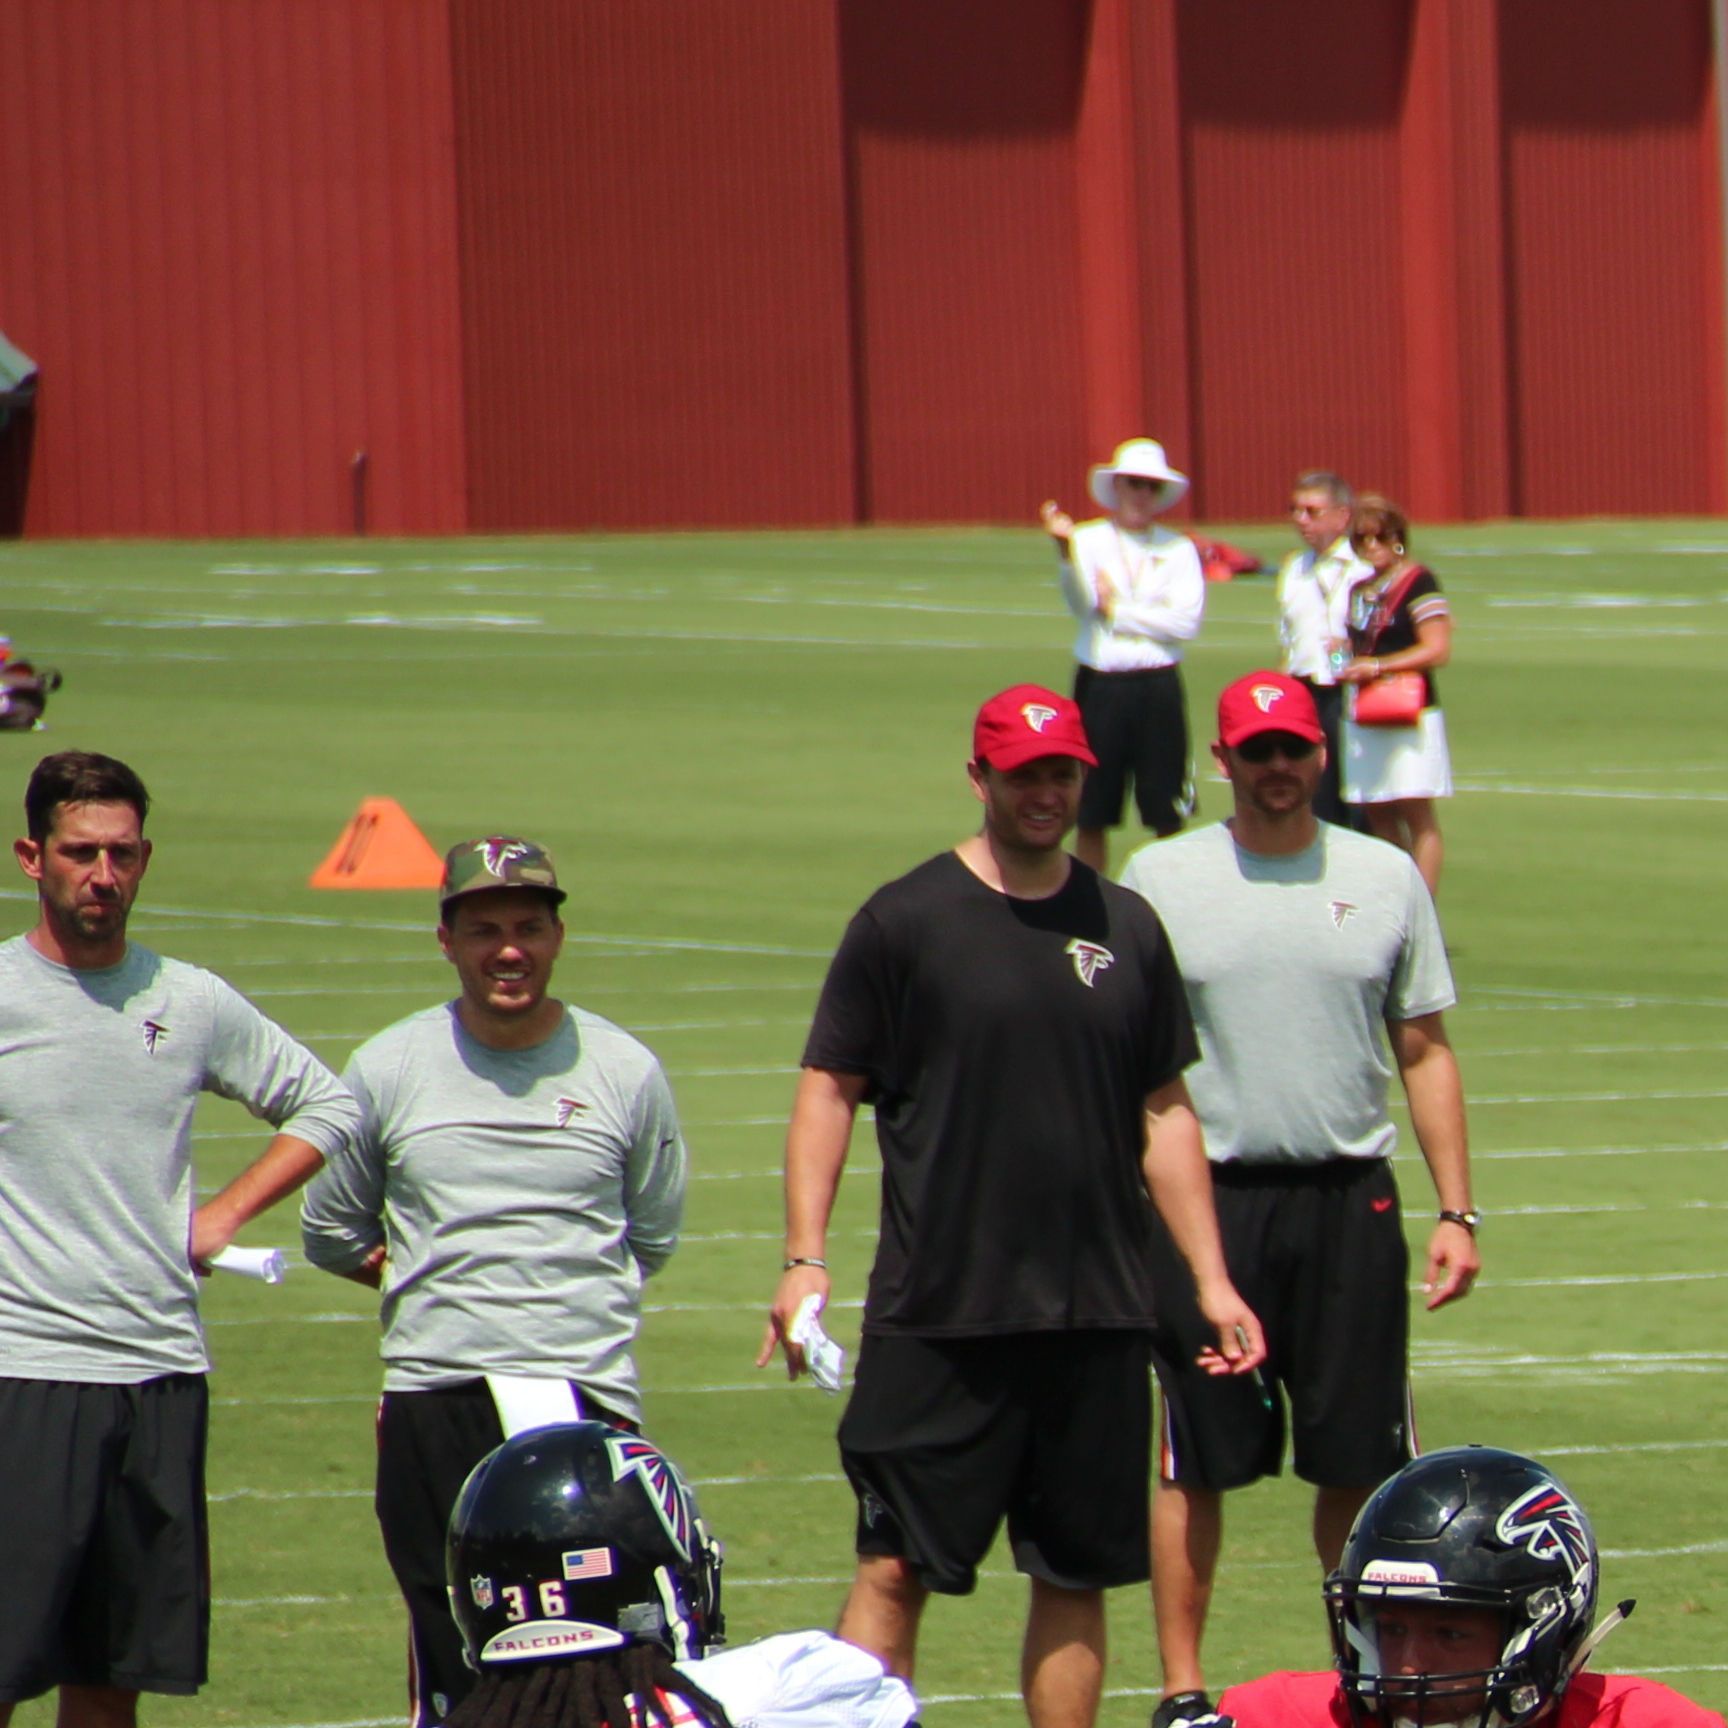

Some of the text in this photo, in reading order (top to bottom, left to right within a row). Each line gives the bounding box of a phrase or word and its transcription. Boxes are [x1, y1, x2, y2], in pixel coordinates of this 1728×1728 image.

[1367, 1572, 1427, 1585] FALCONS
[501, 1580, 567, 1622] 36
[494, 1630, 594, 1652] FALCONS
